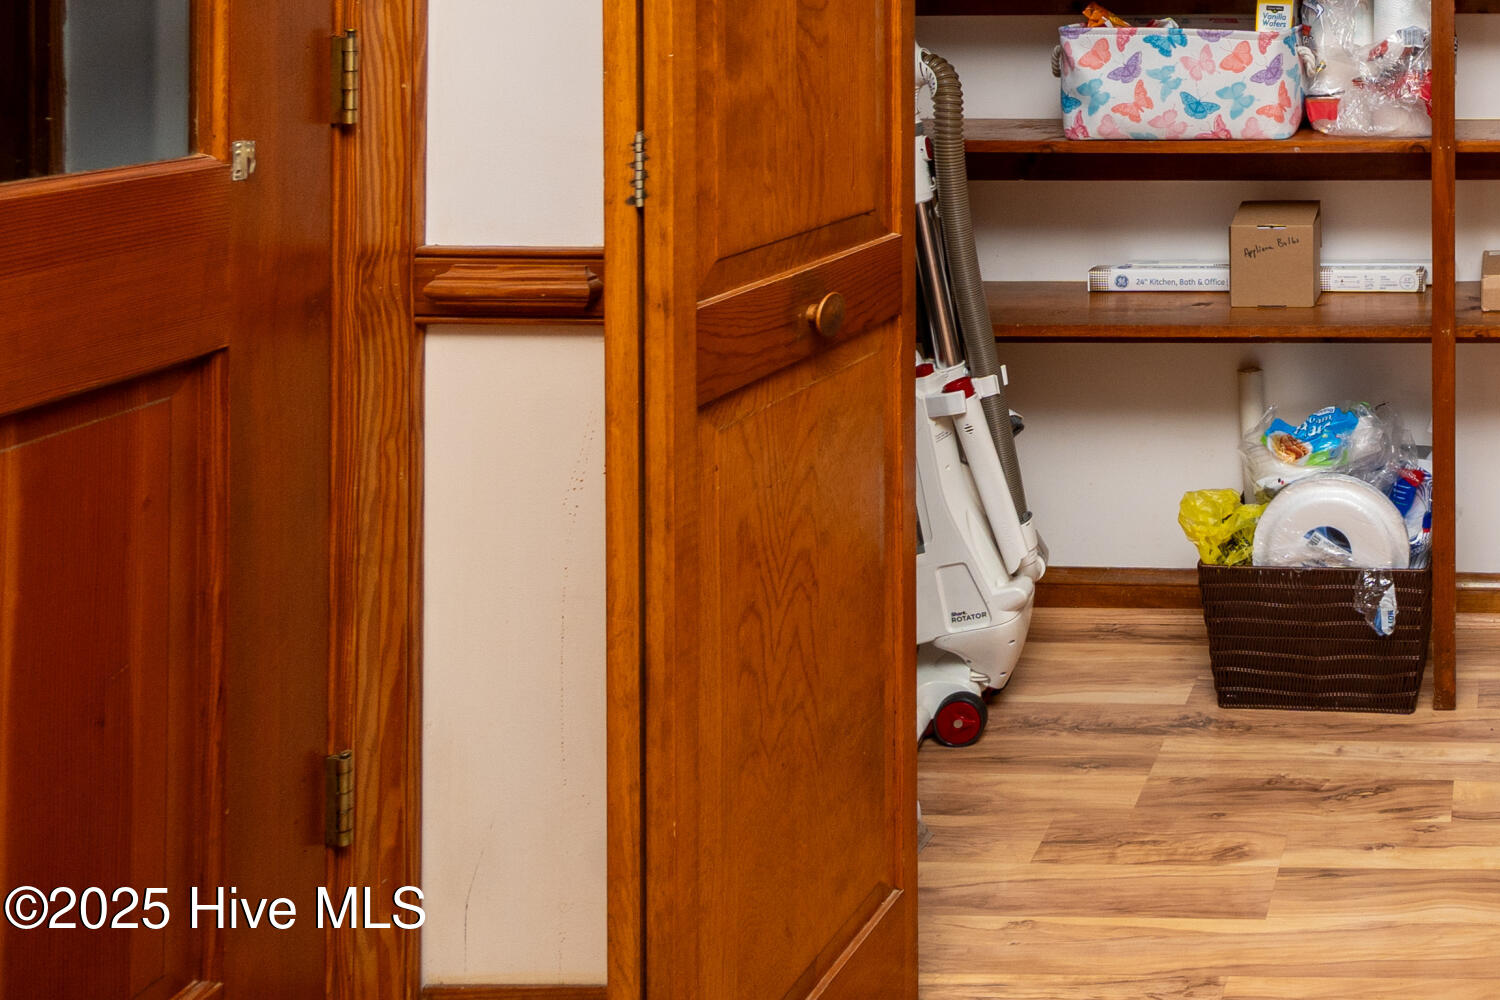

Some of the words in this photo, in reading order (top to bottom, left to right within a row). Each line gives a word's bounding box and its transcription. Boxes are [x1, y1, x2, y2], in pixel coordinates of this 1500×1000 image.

[1263, 12, 1286, 20] Vanilla
[1263, 20, 1286, 28] Wafers
[1149, 278, 1178, 287] Kitchen,
[1204, 278, 1225, 286] Office
[951, 611, 987, 623] ROTATOR
